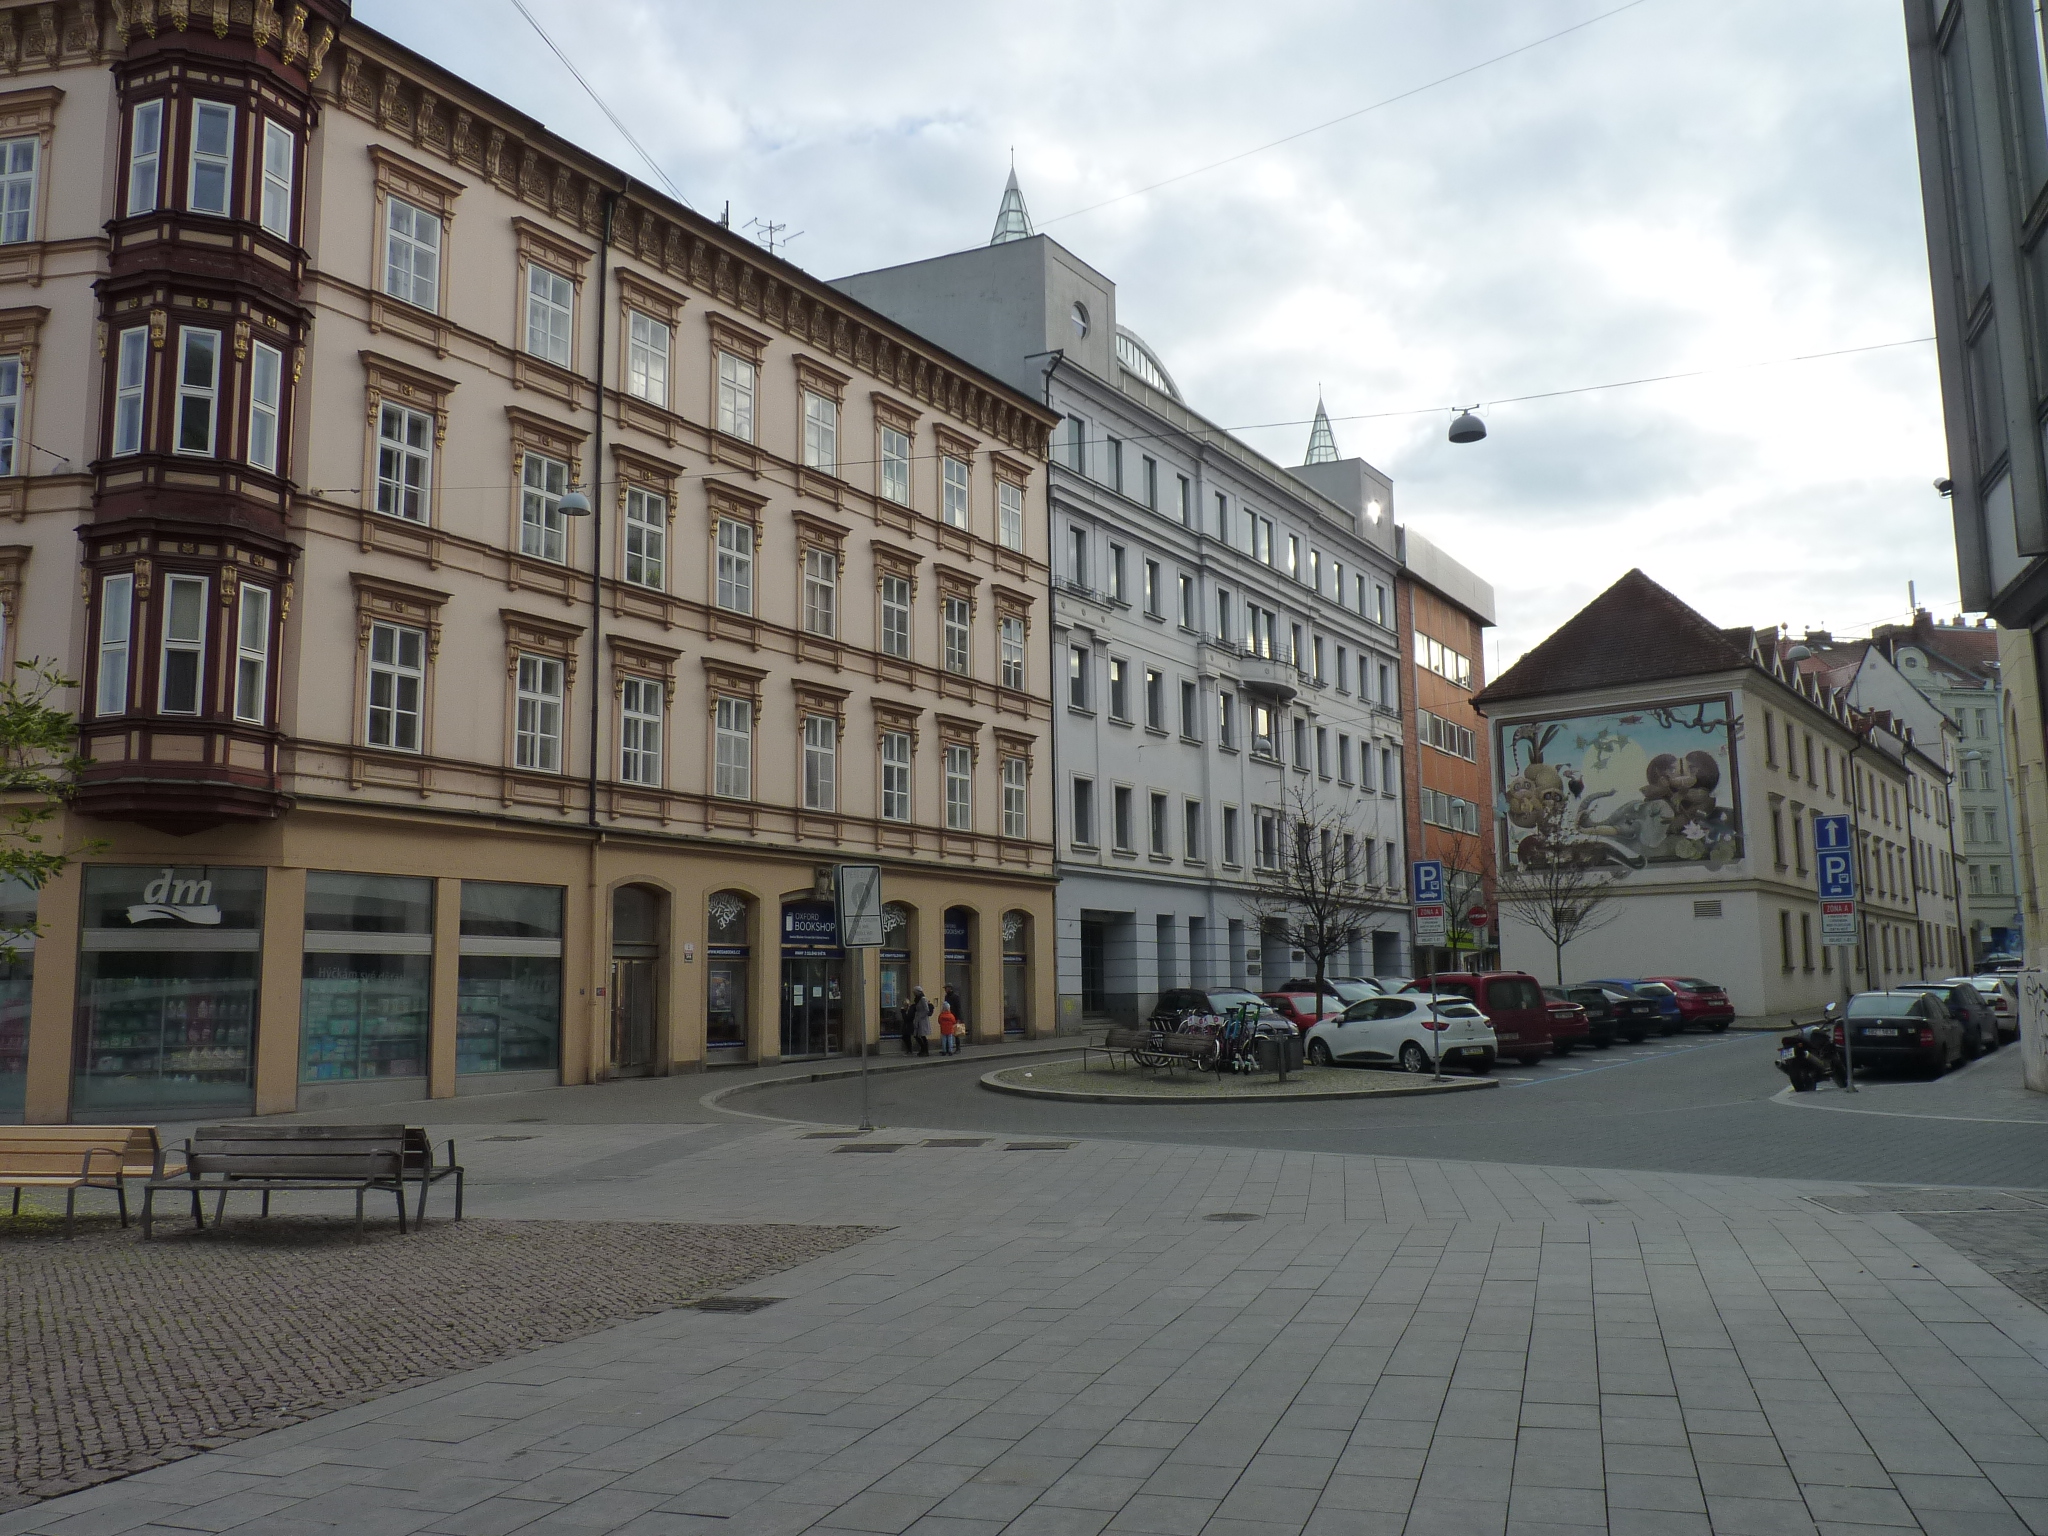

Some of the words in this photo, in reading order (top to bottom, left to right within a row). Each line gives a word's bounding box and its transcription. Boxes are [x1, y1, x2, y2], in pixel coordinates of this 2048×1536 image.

[1826, 857, 1846, 884] P
[1420, 866, 1437, 890] P
[135, 868, 180, 905] dm
[1844, 904, 1849, 912] A
[795, 912, 819, 921] OXFORD
[795, 921, 836, 932] BOOKSHOP
[318, 966, 358, 980] Hýčkám
